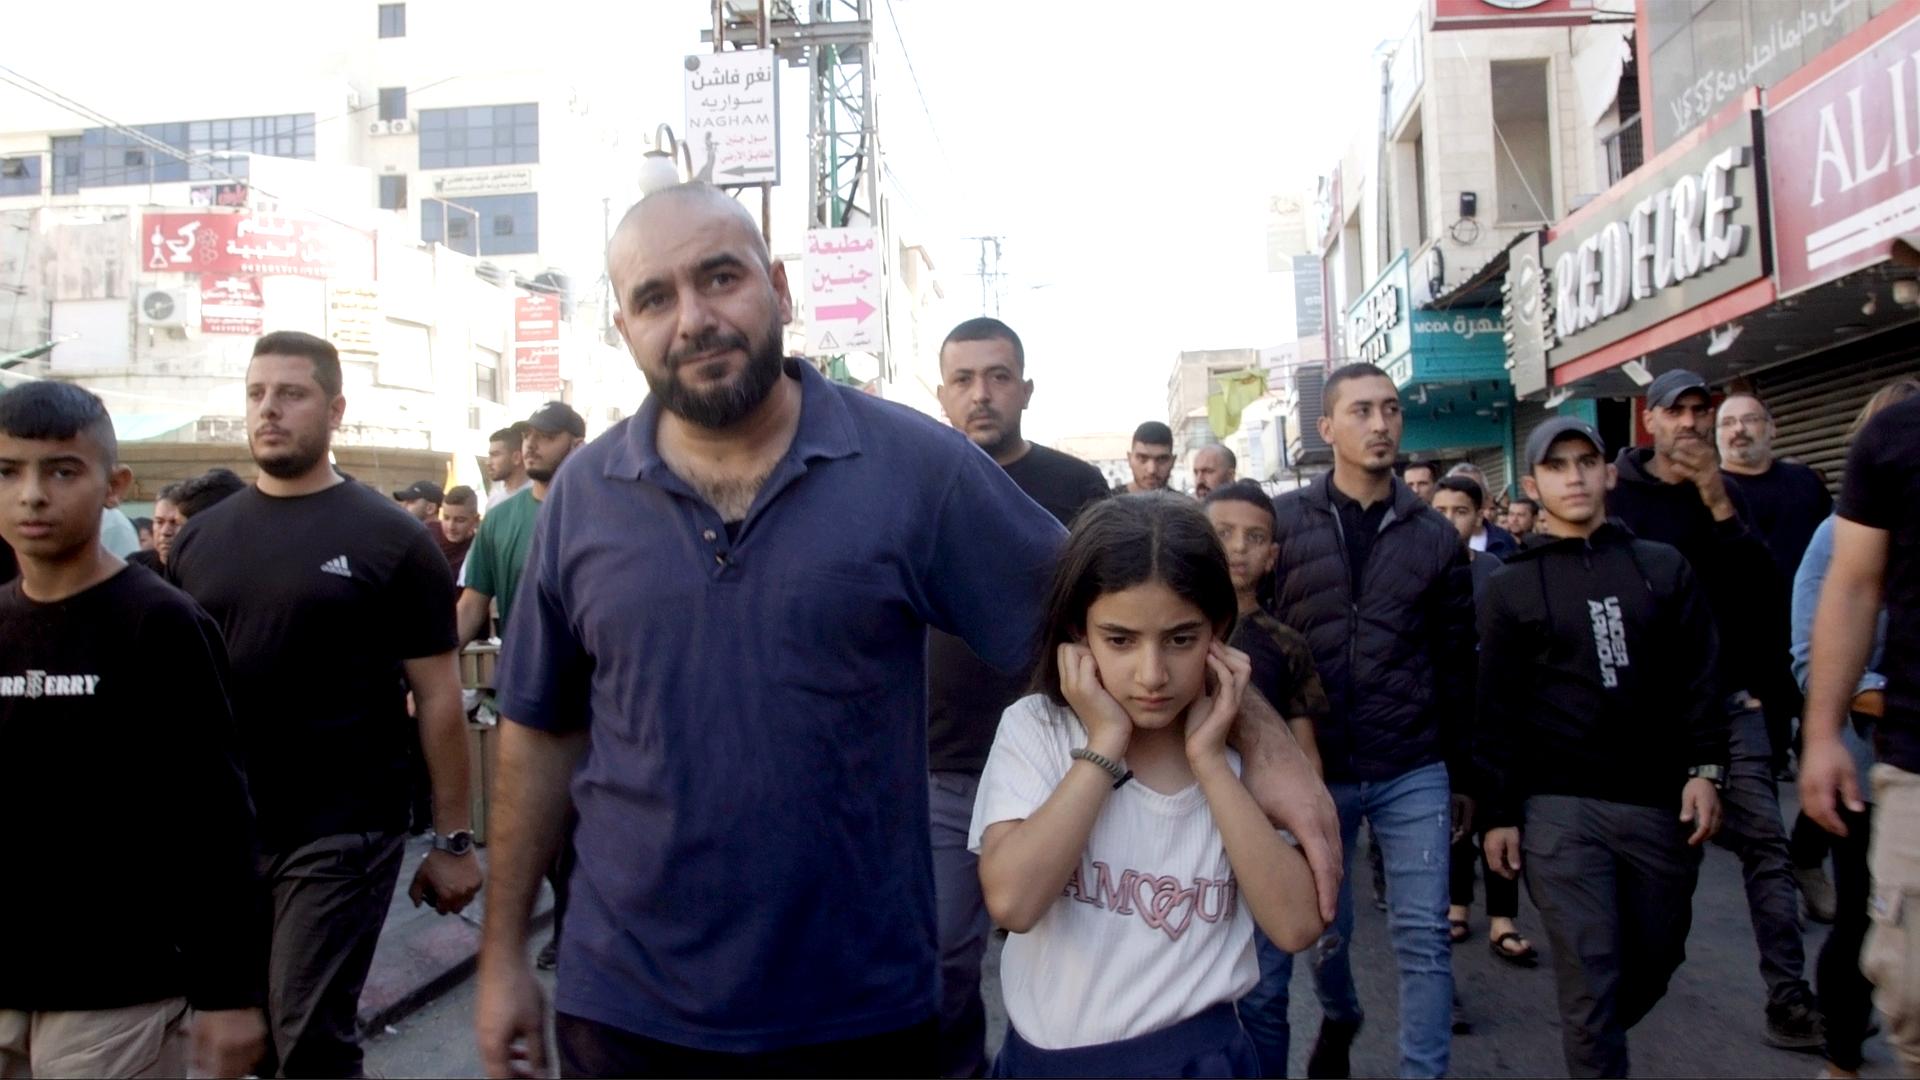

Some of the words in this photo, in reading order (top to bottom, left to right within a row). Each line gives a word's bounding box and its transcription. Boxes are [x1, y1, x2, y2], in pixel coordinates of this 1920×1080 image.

[691, 66, 740, 91] فاشن
[745, 65, 771, 91] نغم
[689, 114, 770, 128] NAGHAM
[1810, 46, 1920, 208] ALI
[809, 233, 873, 260] مطبعة
[812, 264, 872, 293] جنين
[1414, 321, 1450, 333] MODA
[1586, 598, 1619, 689] ARMOUR
[1602, 595, 1630, 668] UNDER
